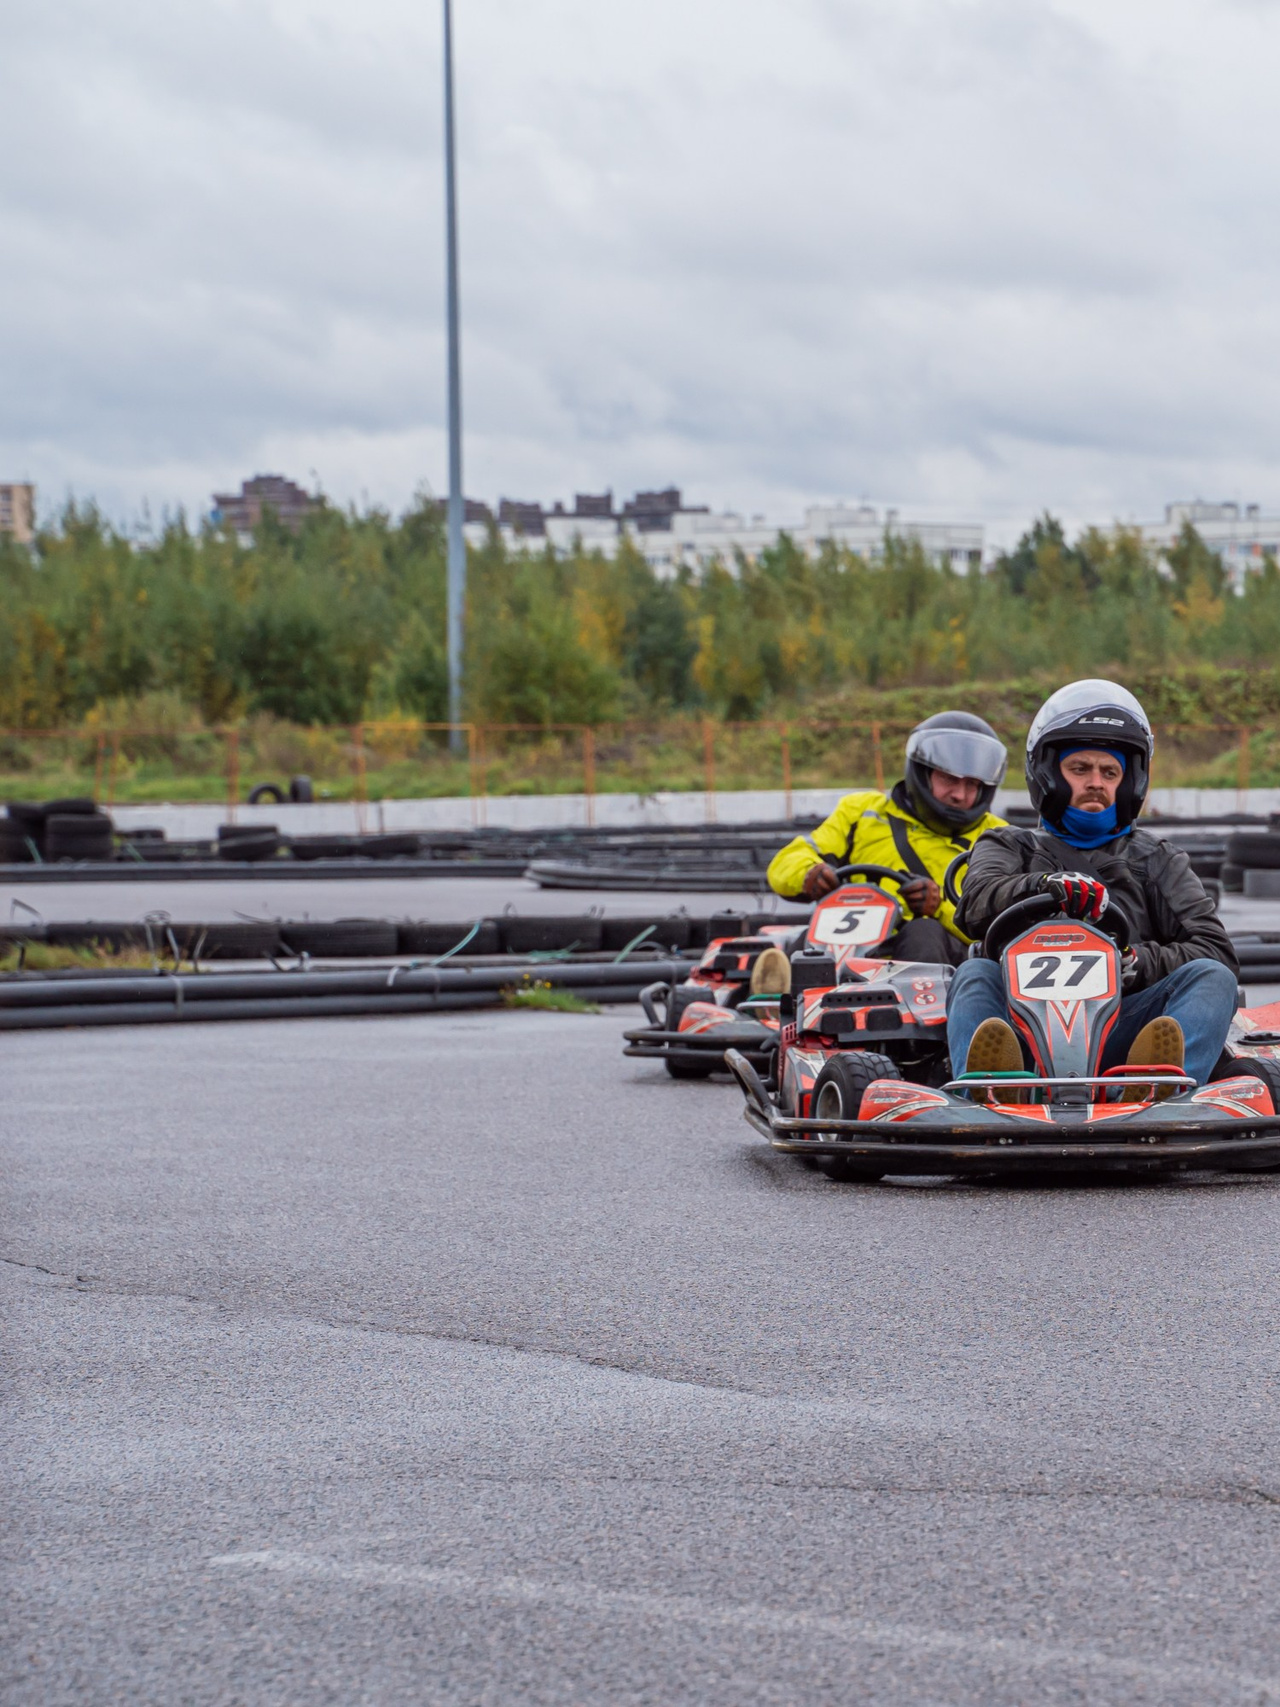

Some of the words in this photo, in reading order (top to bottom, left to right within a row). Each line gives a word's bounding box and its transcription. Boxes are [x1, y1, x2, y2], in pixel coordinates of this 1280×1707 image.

[1078, 716, 1125, 727] LS2
[833, 910, 866, 934] 5
[1023, 955, 1103, 989] 27
